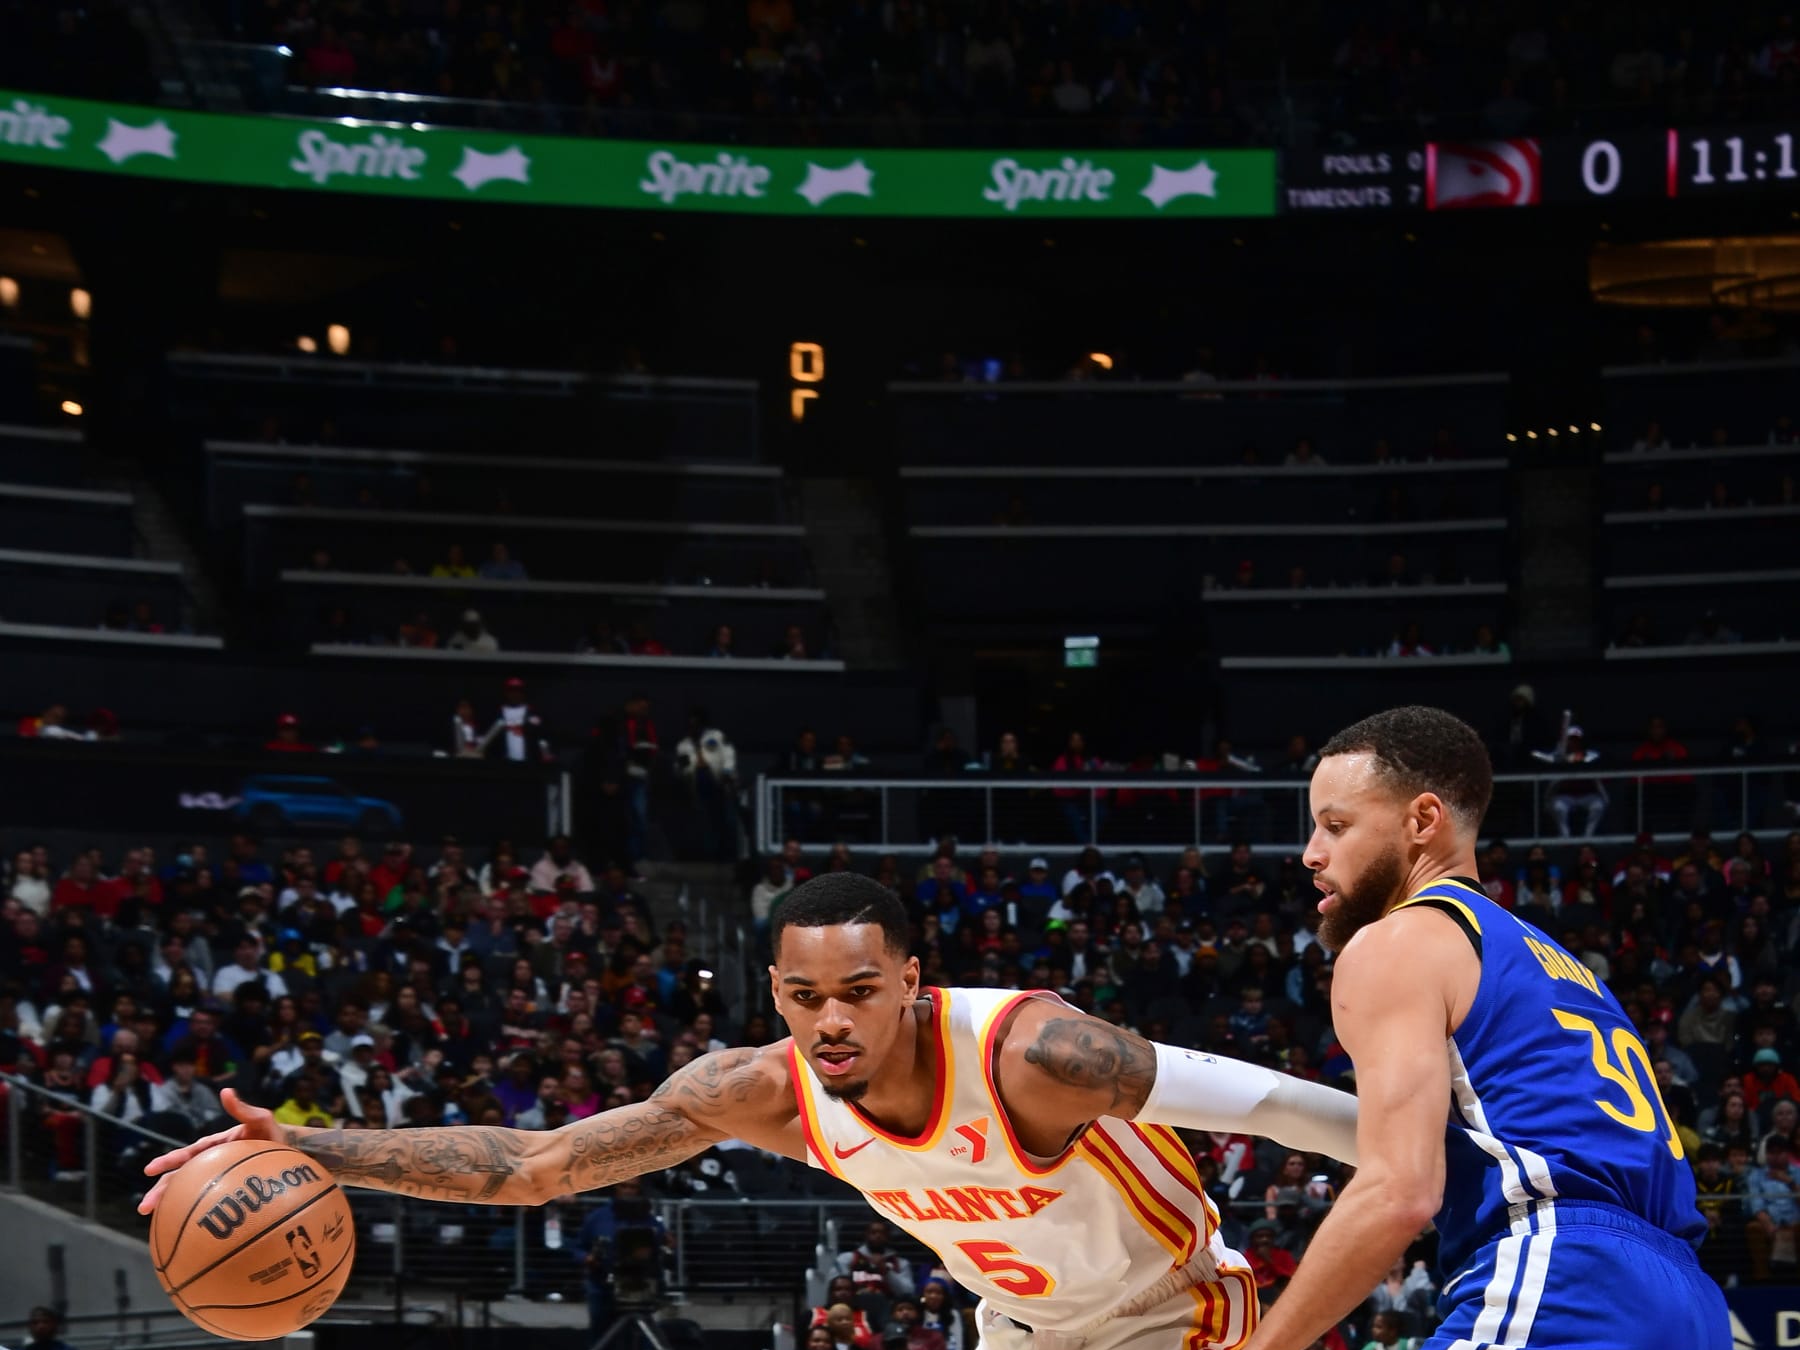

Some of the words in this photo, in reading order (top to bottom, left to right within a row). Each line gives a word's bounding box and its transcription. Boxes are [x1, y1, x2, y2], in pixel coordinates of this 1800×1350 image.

[289, 130, 426, 183] Sprite
[639, 149, 770, 203] Sprite
[983, 156, 1115, 211] Sprite
[1323, 152, 1391, 174] FOULS
[1582, 140, 1621, 195] 0
[1288, 186, 1391, 208] TIMEOUTS
[1551, 1007, 1685, 1161] 30
[950, 1145, 968, 1157] the
[196, 1163, 322, 1241] Wilson
[953, 1239, 1057, 1299] 5
